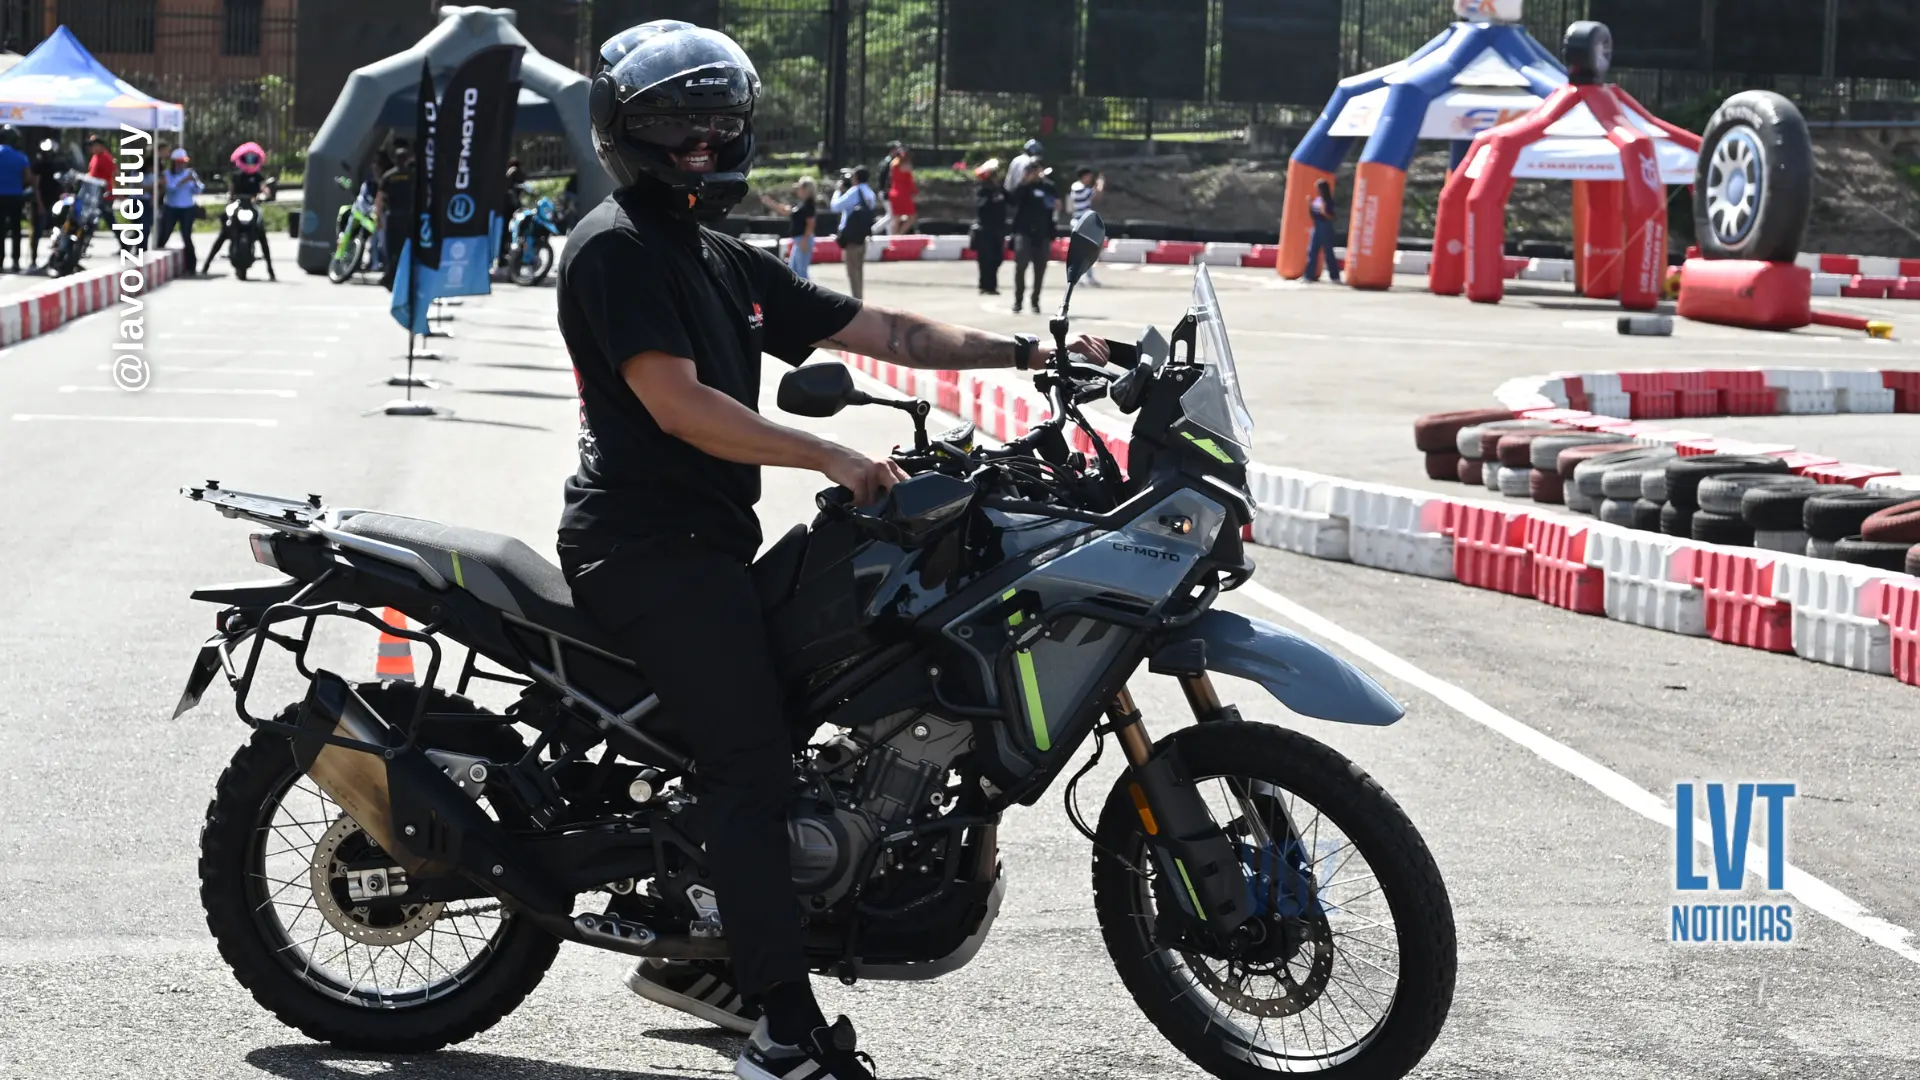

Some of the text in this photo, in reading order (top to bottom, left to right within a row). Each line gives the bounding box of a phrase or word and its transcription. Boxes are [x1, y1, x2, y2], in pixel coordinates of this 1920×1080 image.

[685, 77, 728, 88] LS2
[455, 87, 478, 190] CFMOTO
[1112, 542, 1180, 562] CFMOTO
